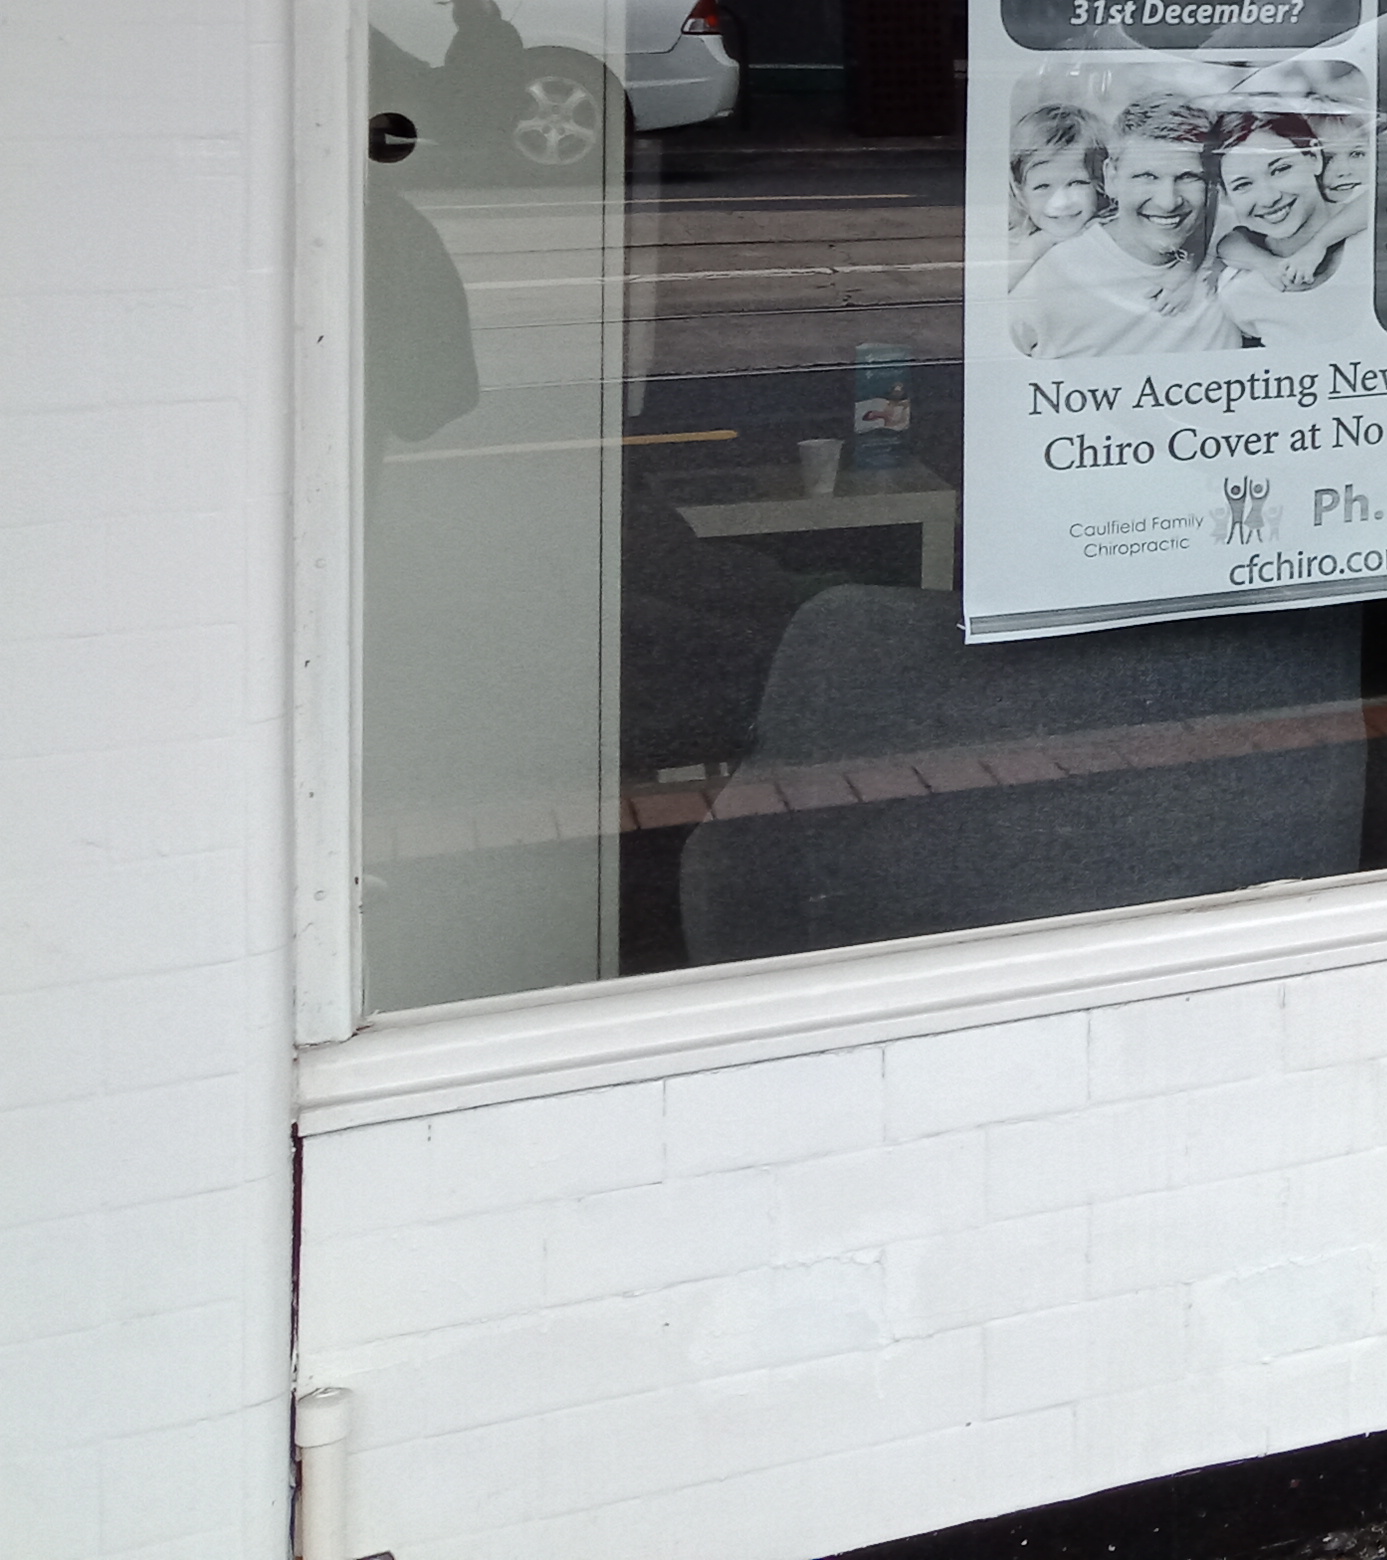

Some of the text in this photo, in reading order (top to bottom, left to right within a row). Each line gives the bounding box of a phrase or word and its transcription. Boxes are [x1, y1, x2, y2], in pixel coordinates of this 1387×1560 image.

[1028, 378, 1122, 416] Now
[1132, 368, 1318, 409] Accepting
[1044, 432, 1156, 471] Chiro
[1167, 429, 1275, 462] Cover
[1289, 422, 1320, 452] at
[1331, 413, 1384, 448] No
[1069, 513, 1204, 538] Caulfield Family
[1312, 482, 1384, 526] Ph.
[1082, 536, 1190, 560] Chiropractic
